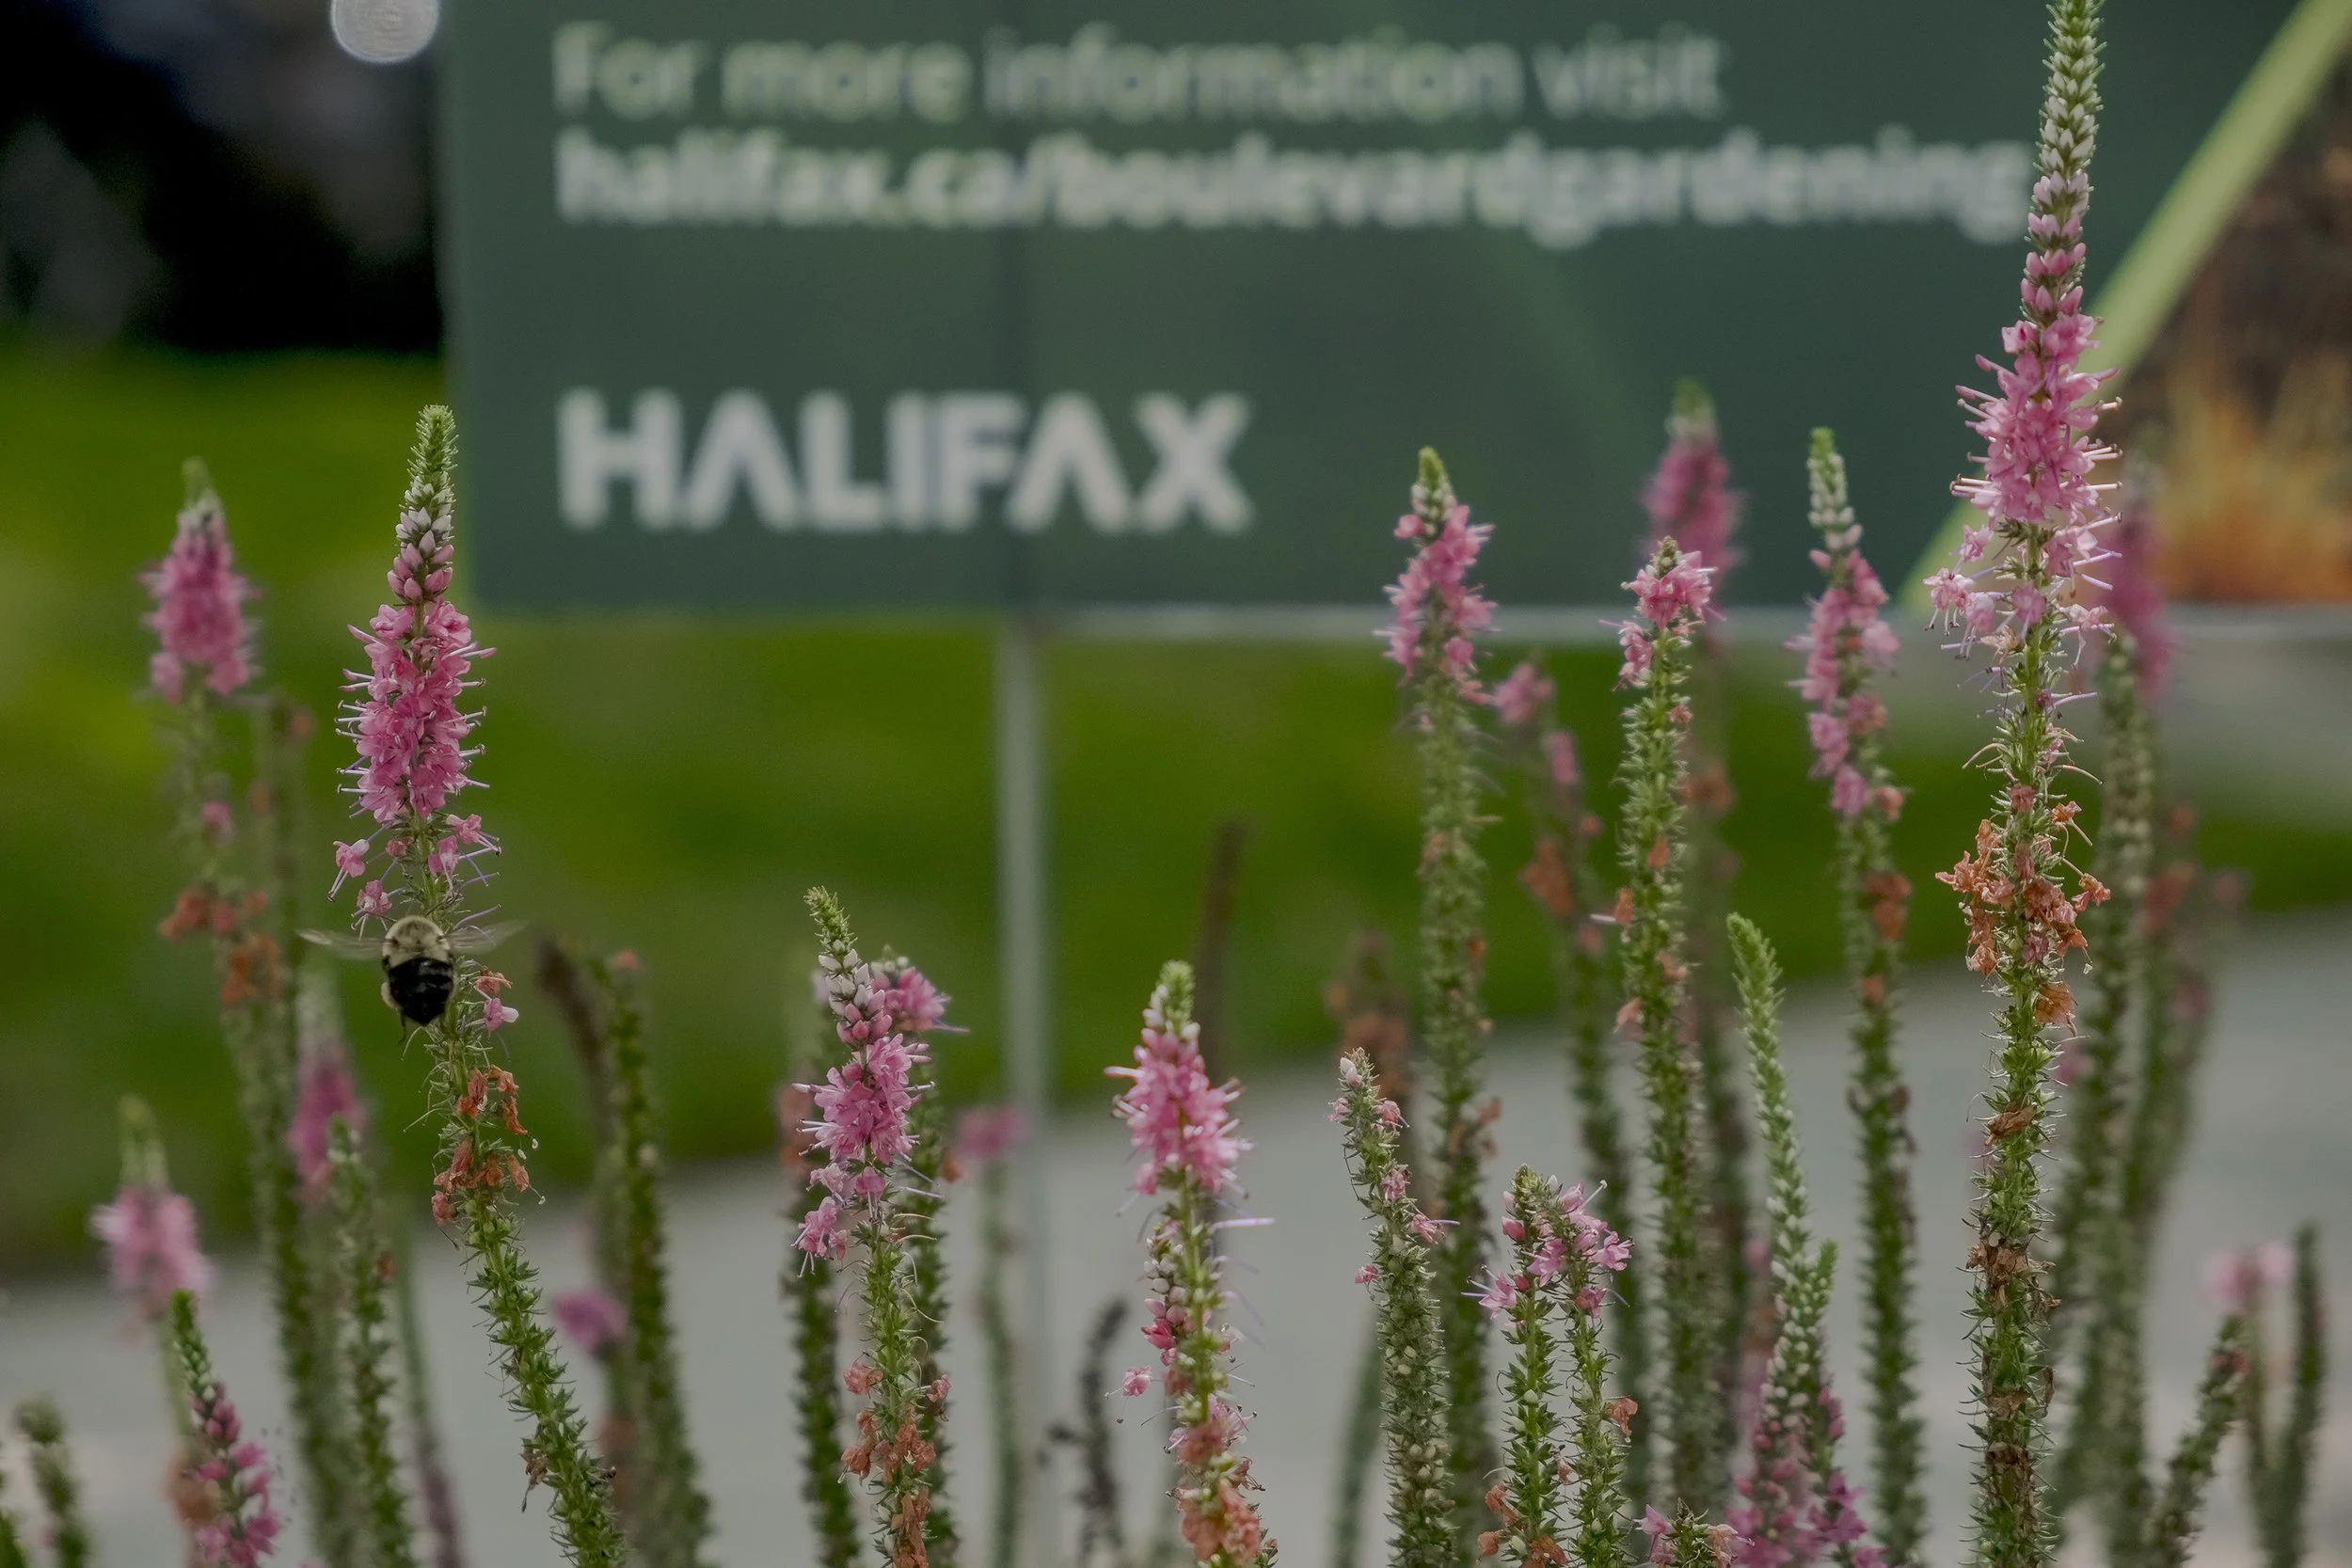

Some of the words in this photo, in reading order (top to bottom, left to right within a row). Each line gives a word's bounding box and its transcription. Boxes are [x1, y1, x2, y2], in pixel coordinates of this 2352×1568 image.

[554, 23, 704, 119] For
[723, 41, 972, 121] more
[984, 24, 1523, 122] information
[1535, 24, 1725, 119] visit
[557, 389, 1251, 533] HALIFAX
